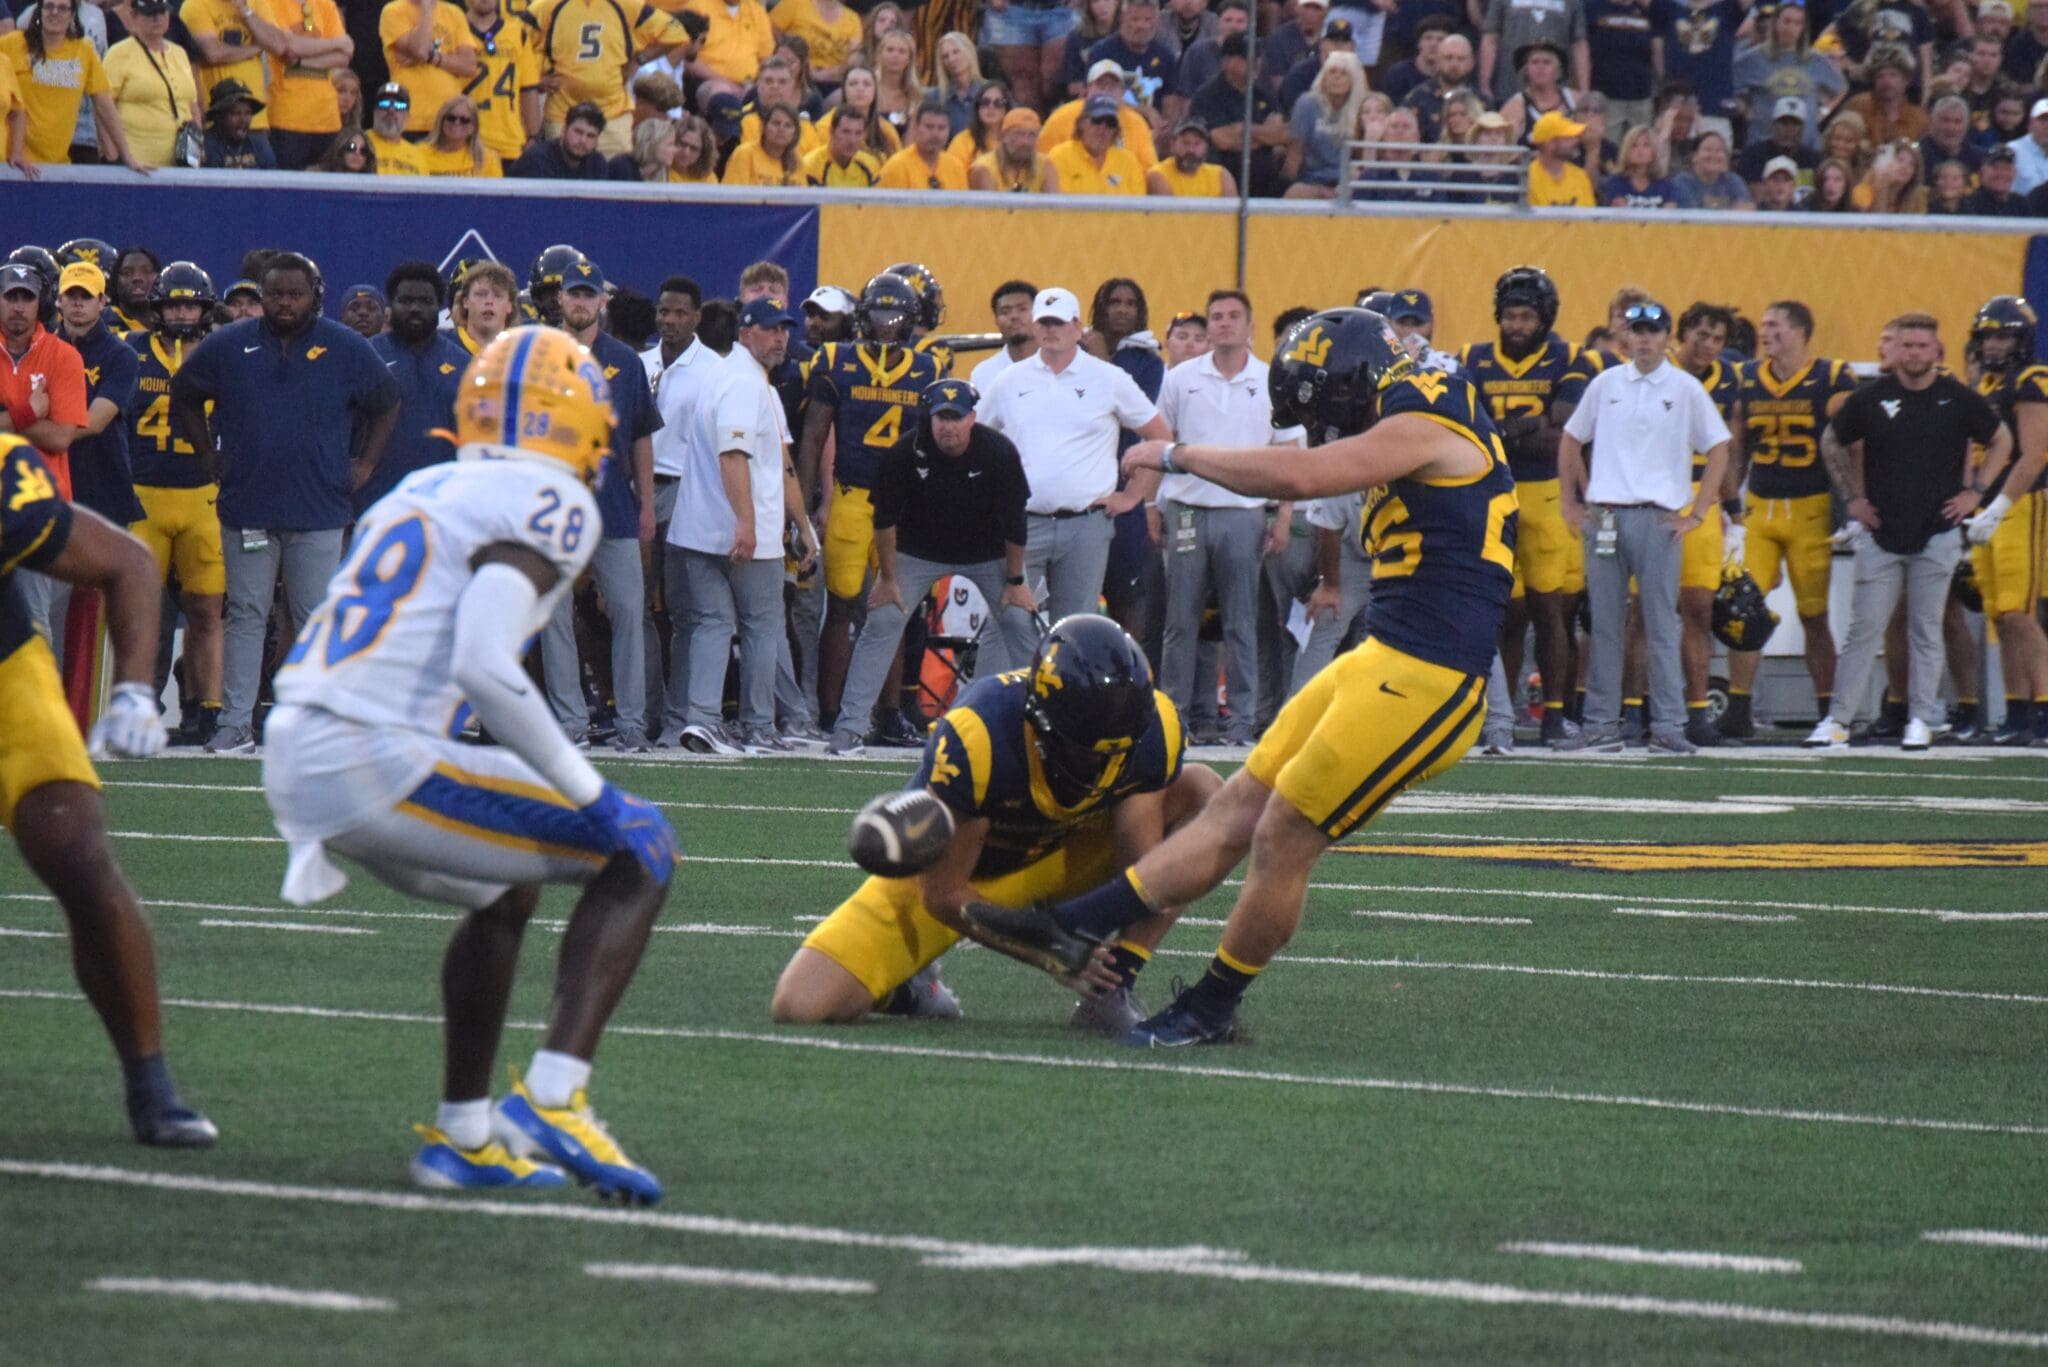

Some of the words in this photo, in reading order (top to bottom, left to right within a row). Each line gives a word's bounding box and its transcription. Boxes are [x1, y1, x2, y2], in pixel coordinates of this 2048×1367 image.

[577, 22, 604, 60] 5
[462, 61, 515, 111] 24
[137, 394, 194, 454] 4
[523, 411, 550, 437] 28
[863, 404, 903, 448] 4
[1747, 414, 1817, 468] 35
[527, 486, 586, 554] 28
[1360, 495, 1424, 580] 6
